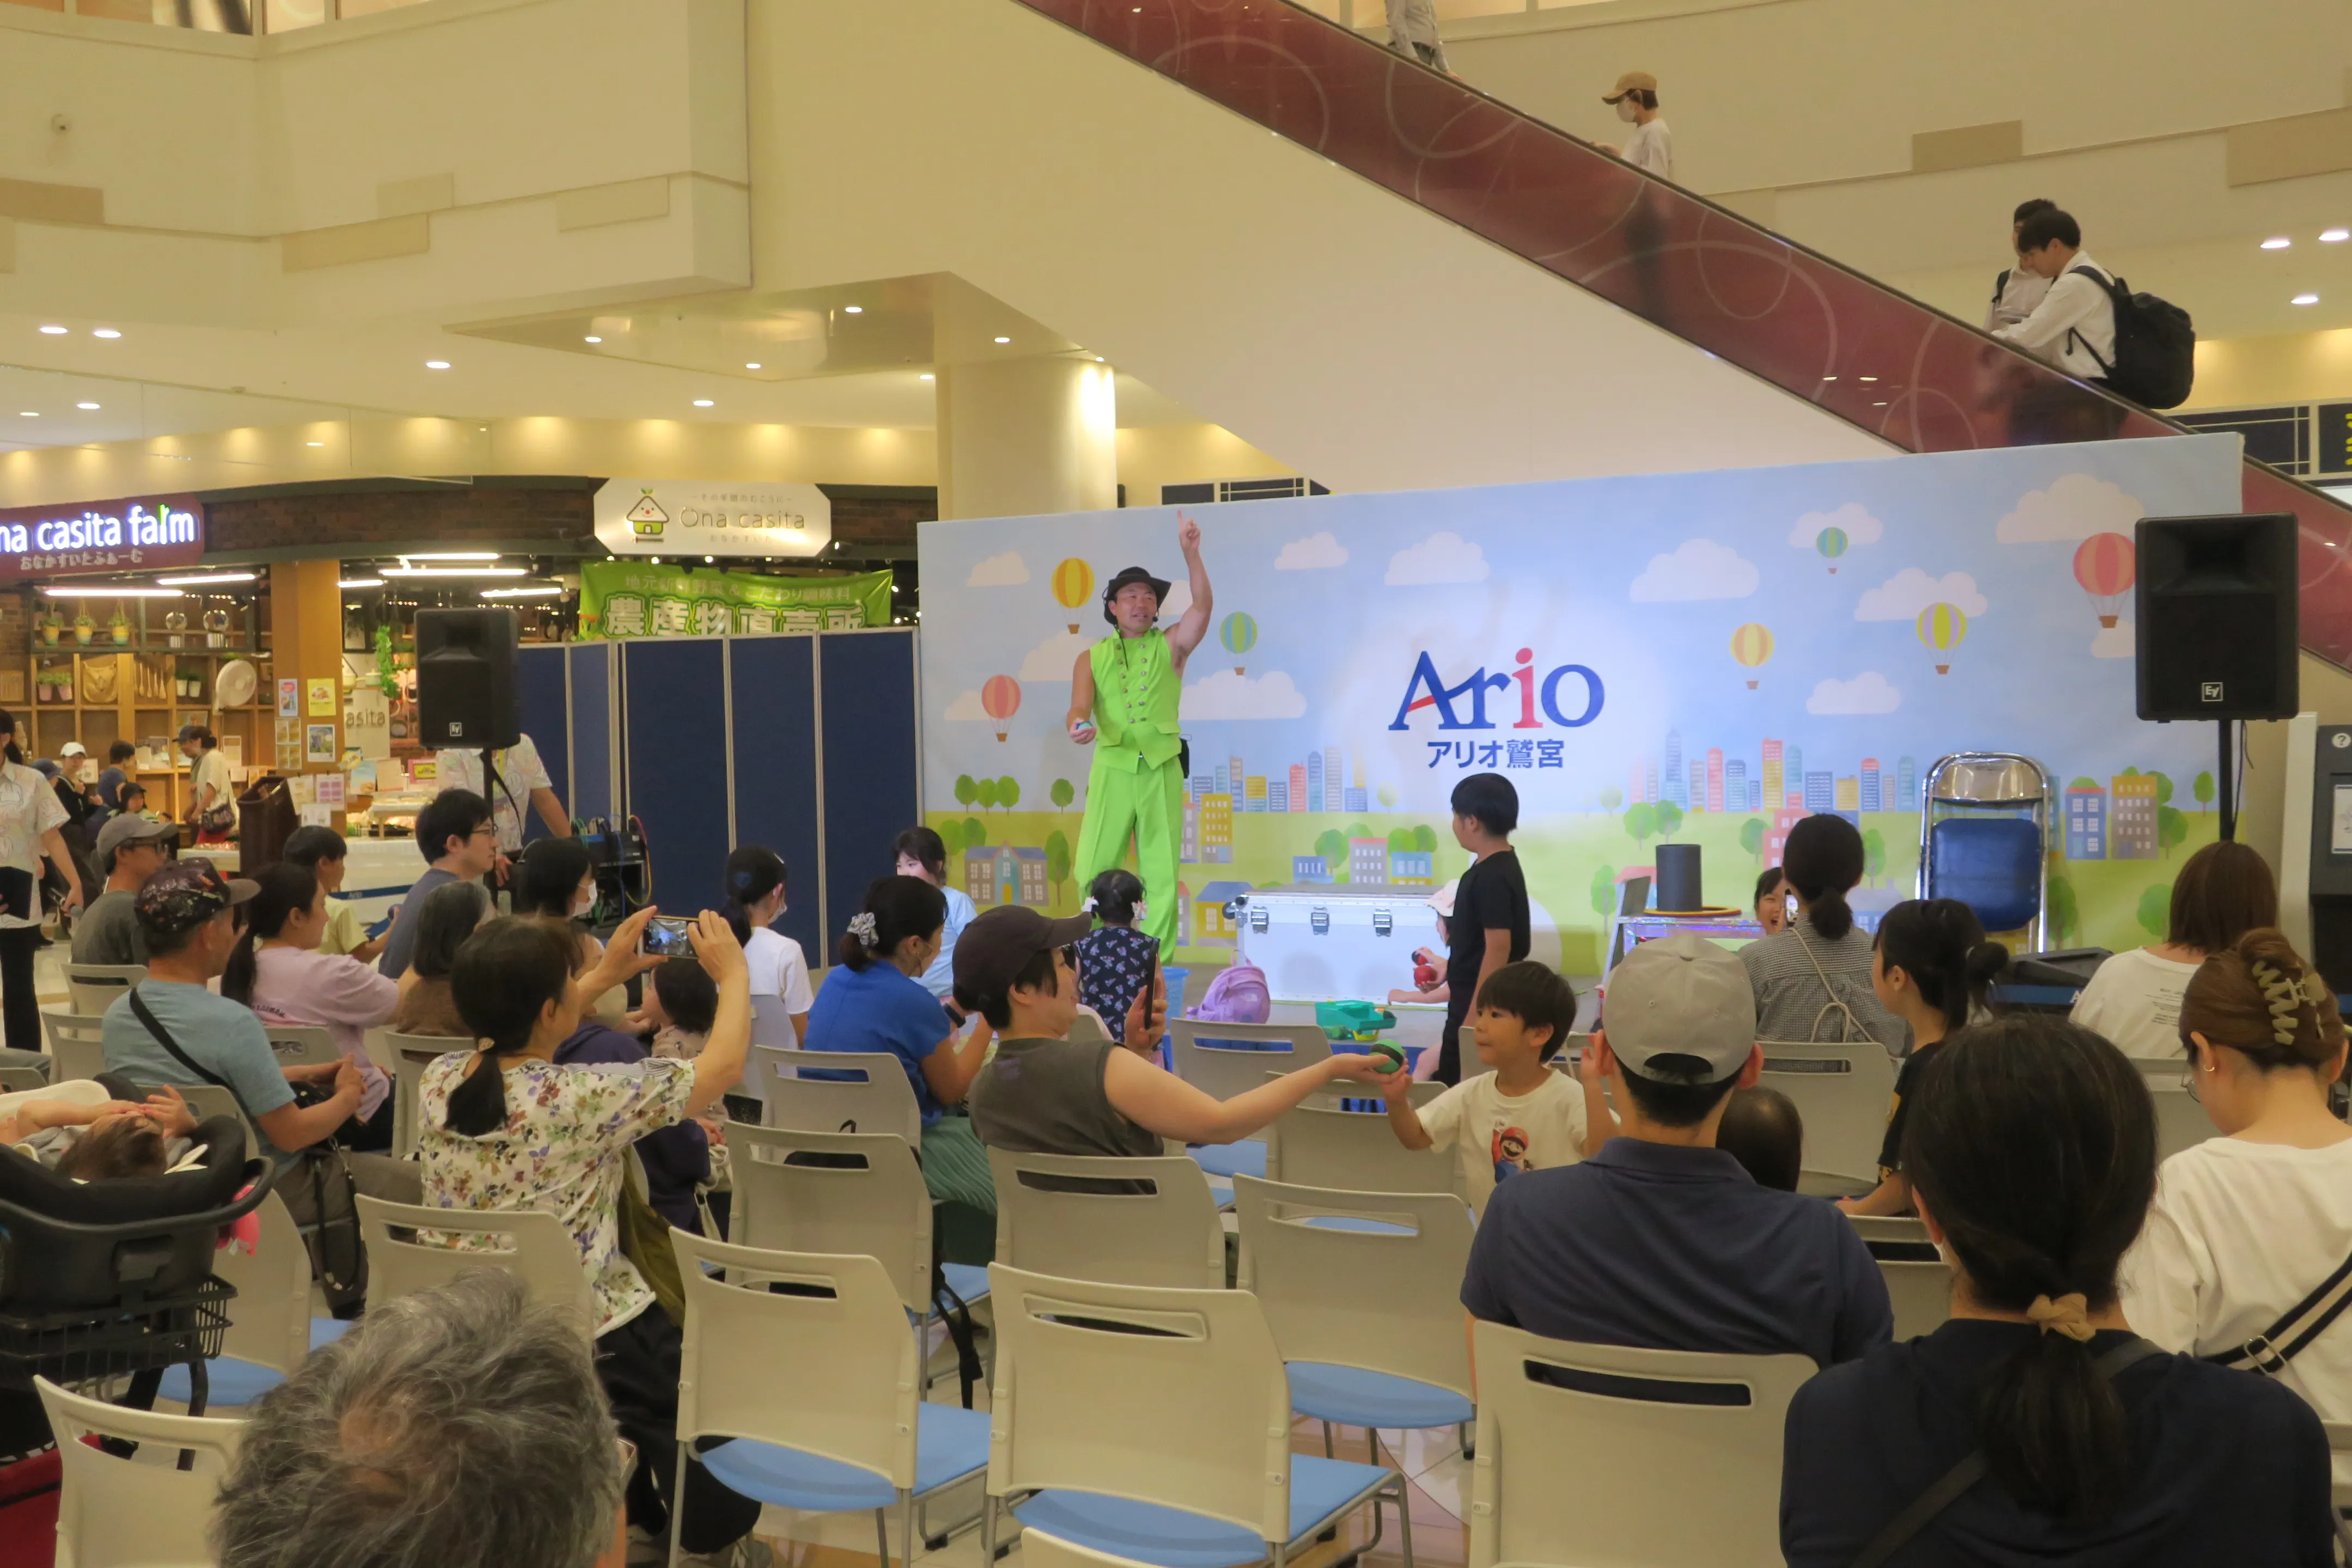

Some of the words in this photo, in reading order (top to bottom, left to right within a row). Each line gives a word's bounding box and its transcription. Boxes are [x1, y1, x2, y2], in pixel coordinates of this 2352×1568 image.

[0, 525, 27, 553] na
[37, 512, 121, 550] casita
[128, 504, 194, 546] farm
[679, 506, 728, 528] Ona
[738, 510, 805, 529] casita
[1388, 647, 1605, 730] Ario
[346, 709, 385, 726] asita
[1427, 739, 1565, 769] アリオ鷲宮
